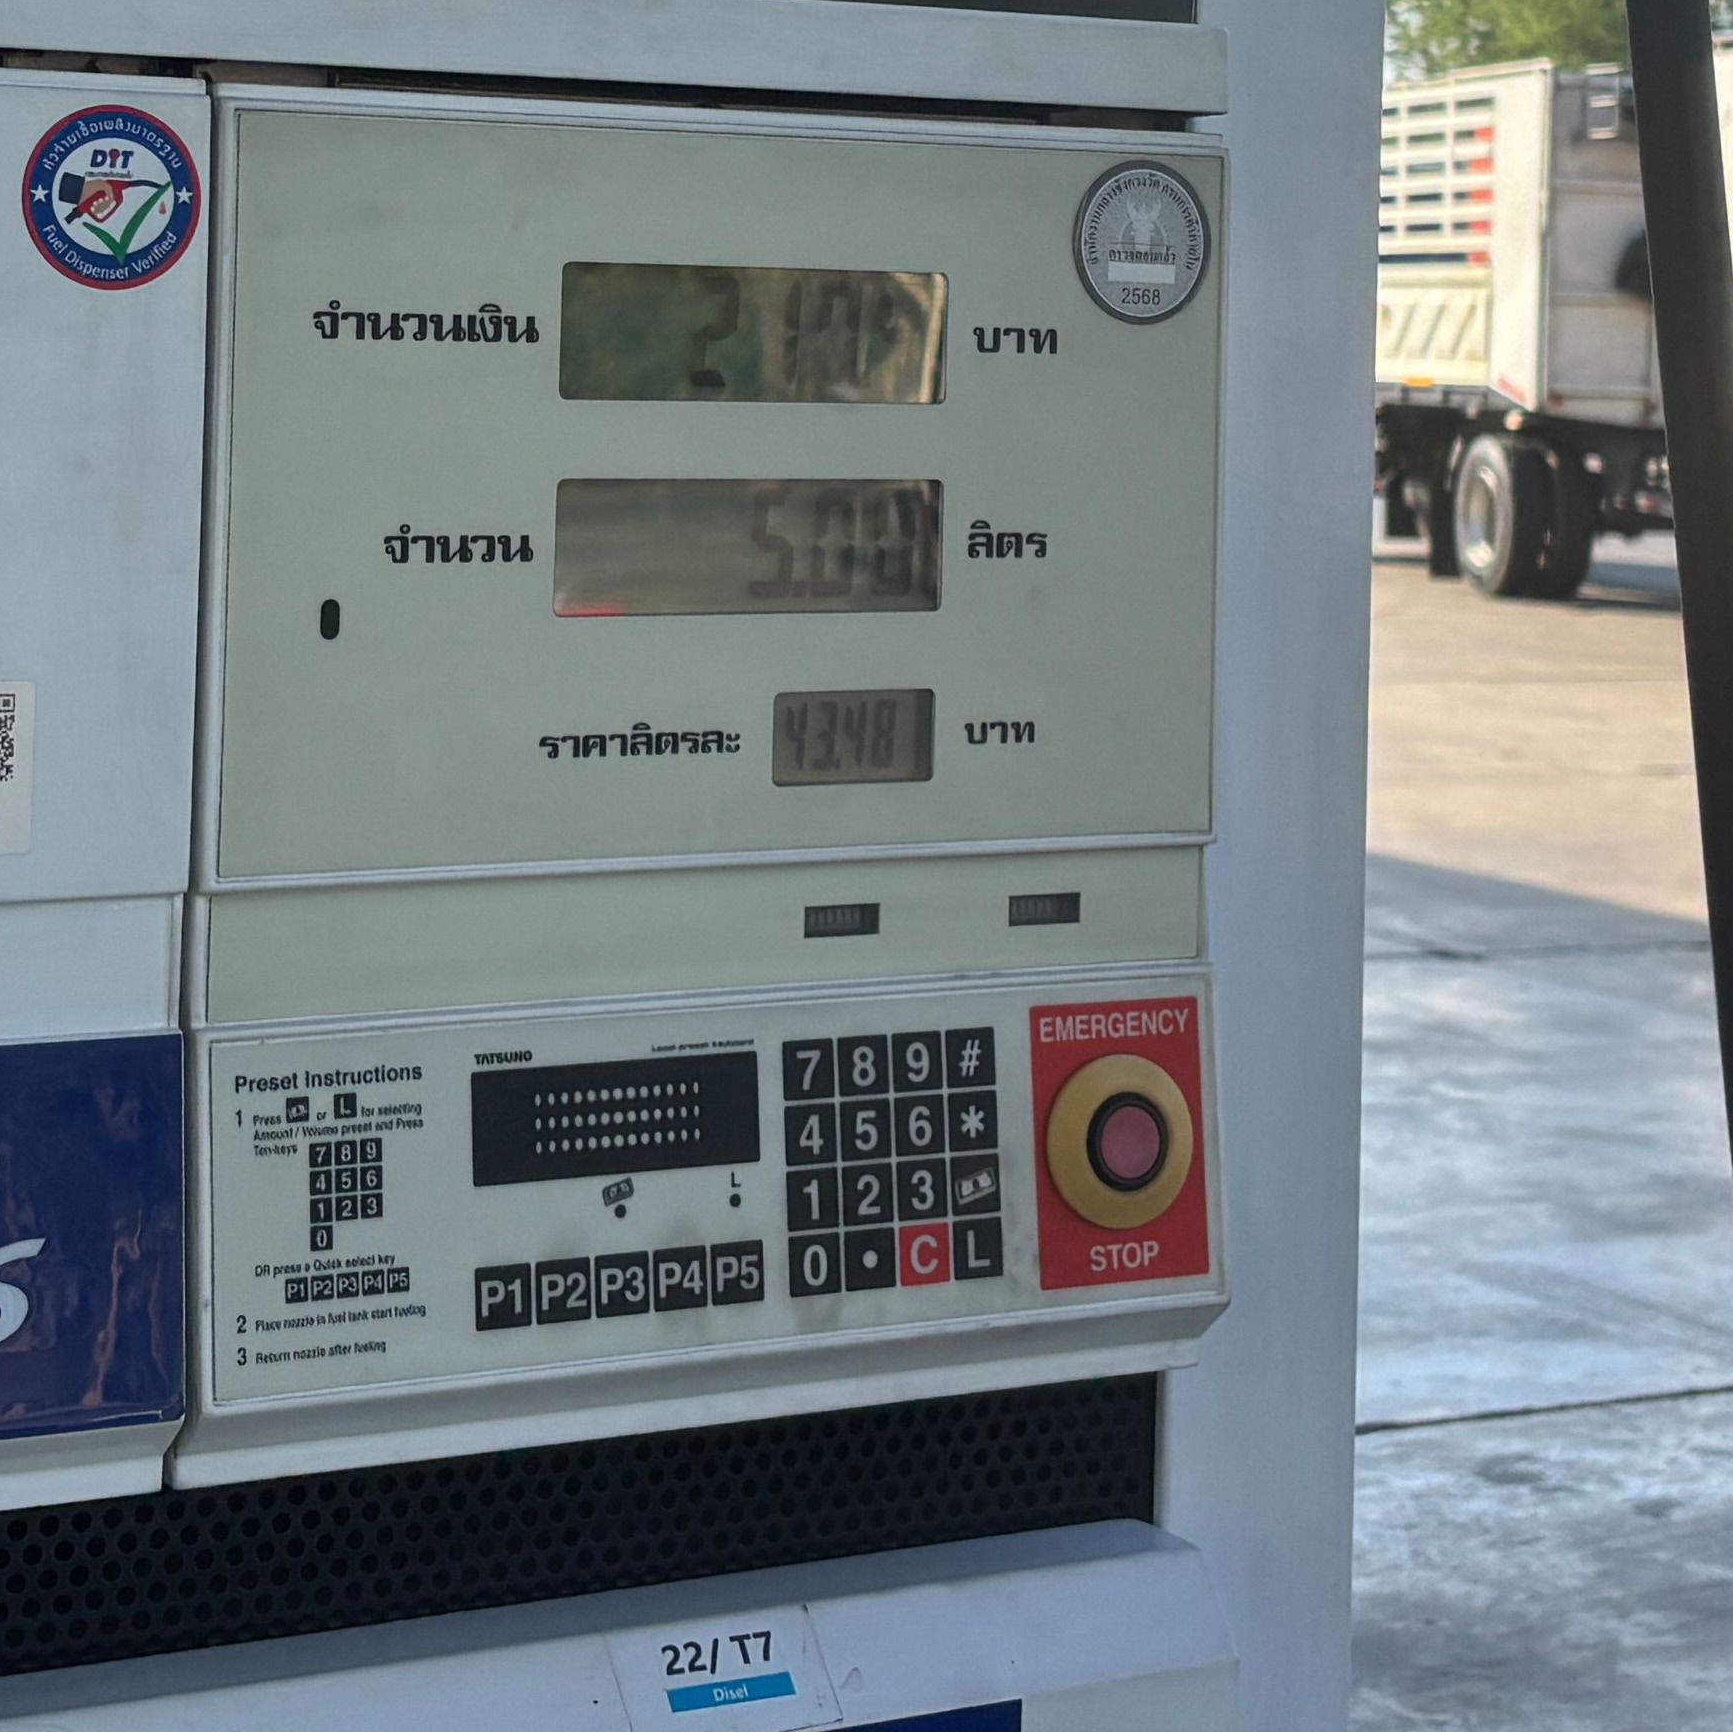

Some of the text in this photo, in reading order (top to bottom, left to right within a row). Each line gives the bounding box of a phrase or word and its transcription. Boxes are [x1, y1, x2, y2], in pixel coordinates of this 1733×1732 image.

[43, 224, 178, 280] Fuel Dispenser Verified
[1121, 287, 1161, 306] 2568
[312, 300, 540, 343] จำนวนเงิน
[974, 325, 1058, 355] บาท
[383, 524, 534, 564] จำนวน
[967, 520, 1048, 559] ลิตร
[539, 723, 741, 760] ราคาลิตรละ
[965, 718, 1036, 745] บาท
[1039, 1008, 1190, 1044] EMERGENCY
[474, 1050, 533, 1066] TATSUNO
[797, 1039, 982, 1090] 7 8 9 #
[234, 1064, 423, 1094] Preset Instructions
[235, 1108, 243, 1128] 1
[253, 1114, 282, 1127] Press
[340, 1097, 352, 1115] L
[799, 1106, 933, 1155] 4 5 6
[316, 1145, 326, 1164] 7
[341, 1144, 352, 1161] 8
[366, 1142, 377, 1159] 9
[316, 1170, 378, 1192] 4 5 6
[730, 1172, 741, 1189] L
[803, 1170, 935, 1221] 1 2 3
[317, 1197, 378, 1220] 1 2 3
[317, 1229, 328, 1248] 0
[803, 1229, 991, 1287] 0 C L
[1090, 1240, 1160, 1273] STOP
[287, 1273, 408, 1298] P1 P2 P3 P4 P5
[480, 1253, 760, 1317] P1 P2 P3 P4 P5
[236, 1314, 247, 1334] 2
[236, 1347, 247, 1367] 3
[729, 1630, 772, 1665] T7
[712, 1684, 749, 1702] Disel
